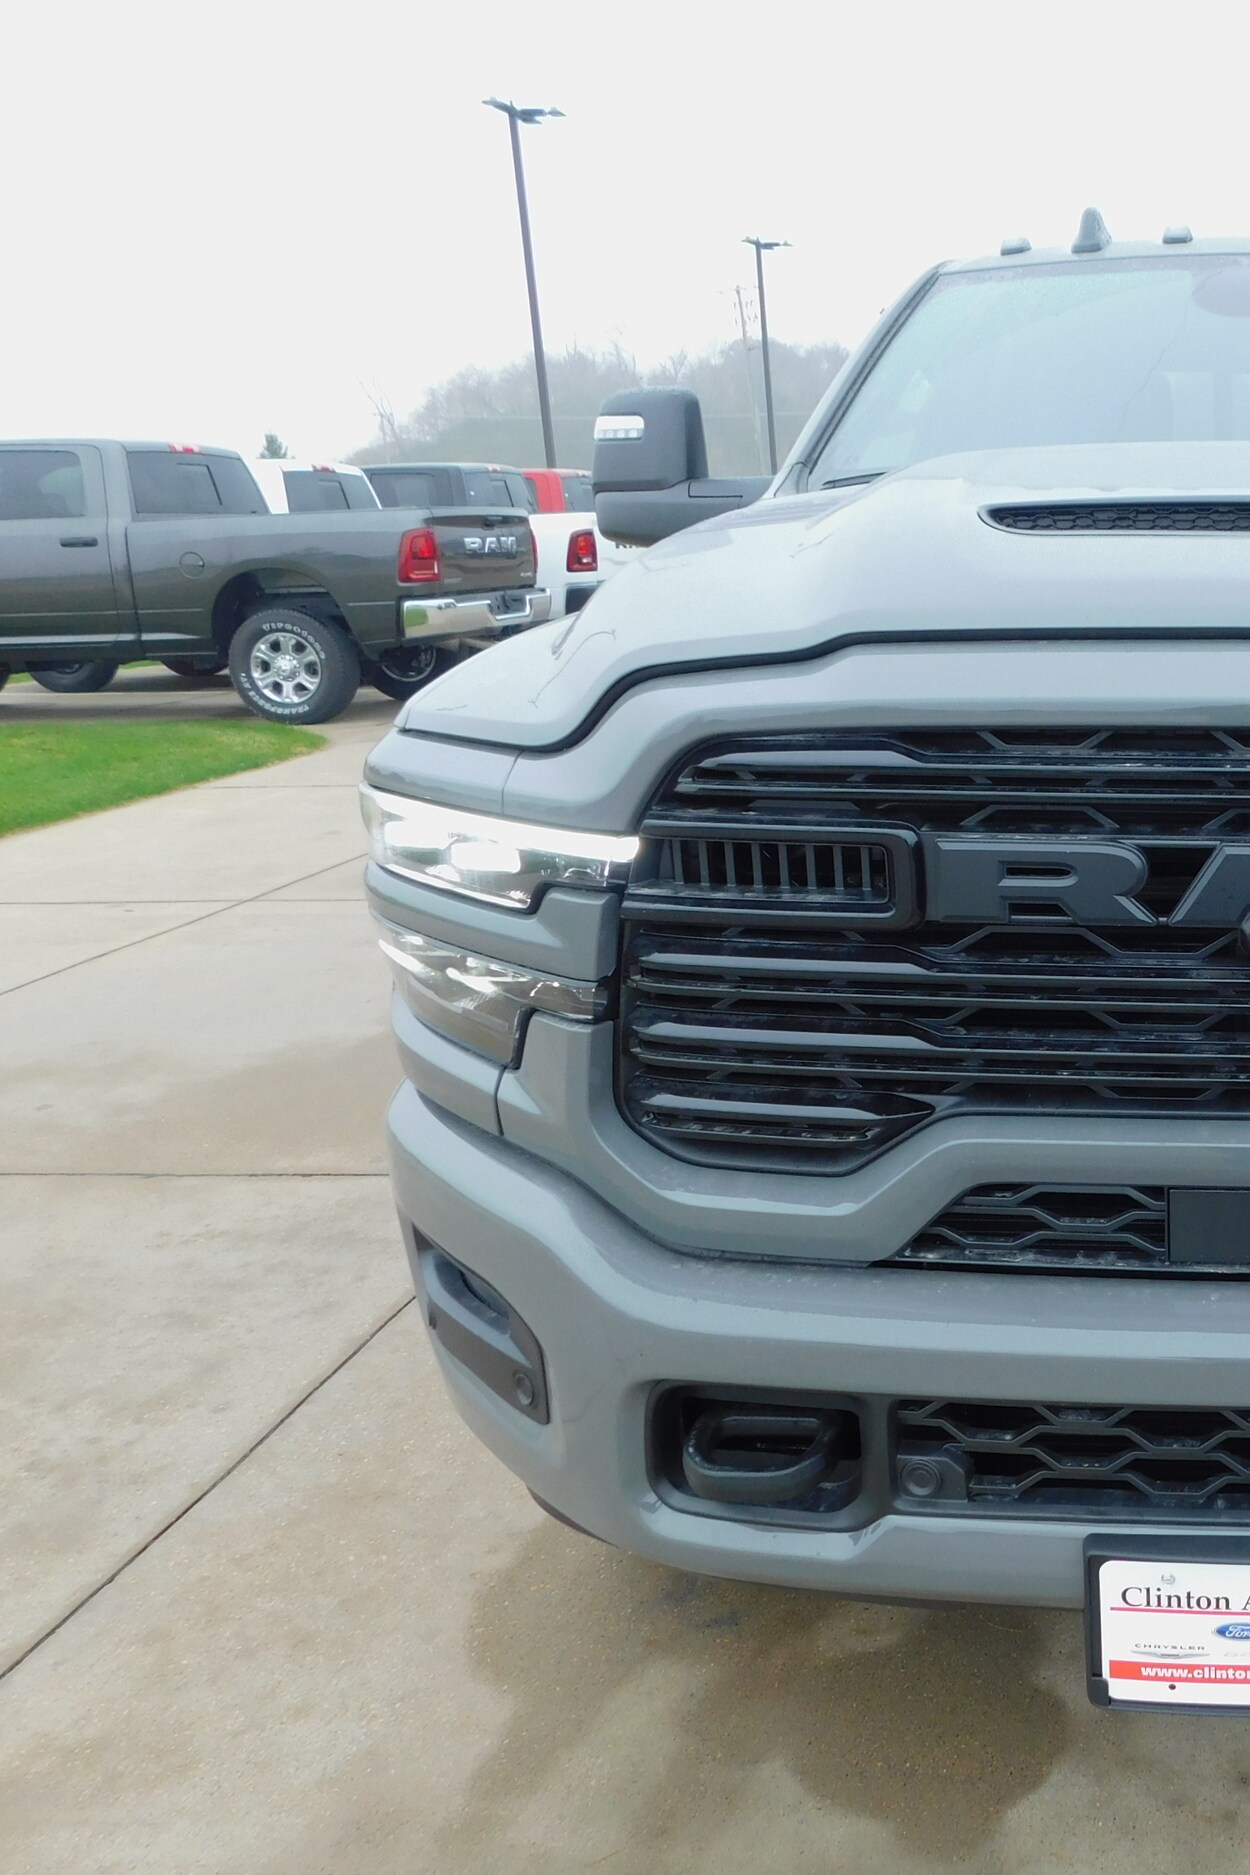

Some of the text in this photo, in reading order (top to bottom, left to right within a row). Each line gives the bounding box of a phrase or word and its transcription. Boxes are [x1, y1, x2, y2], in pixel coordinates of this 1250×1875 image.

[463, 536, 517, 554] RAM
[1121, 1586, 1232, 1611] Clinton
[1134, 1643, 1206, 1652] CHRYSLER
